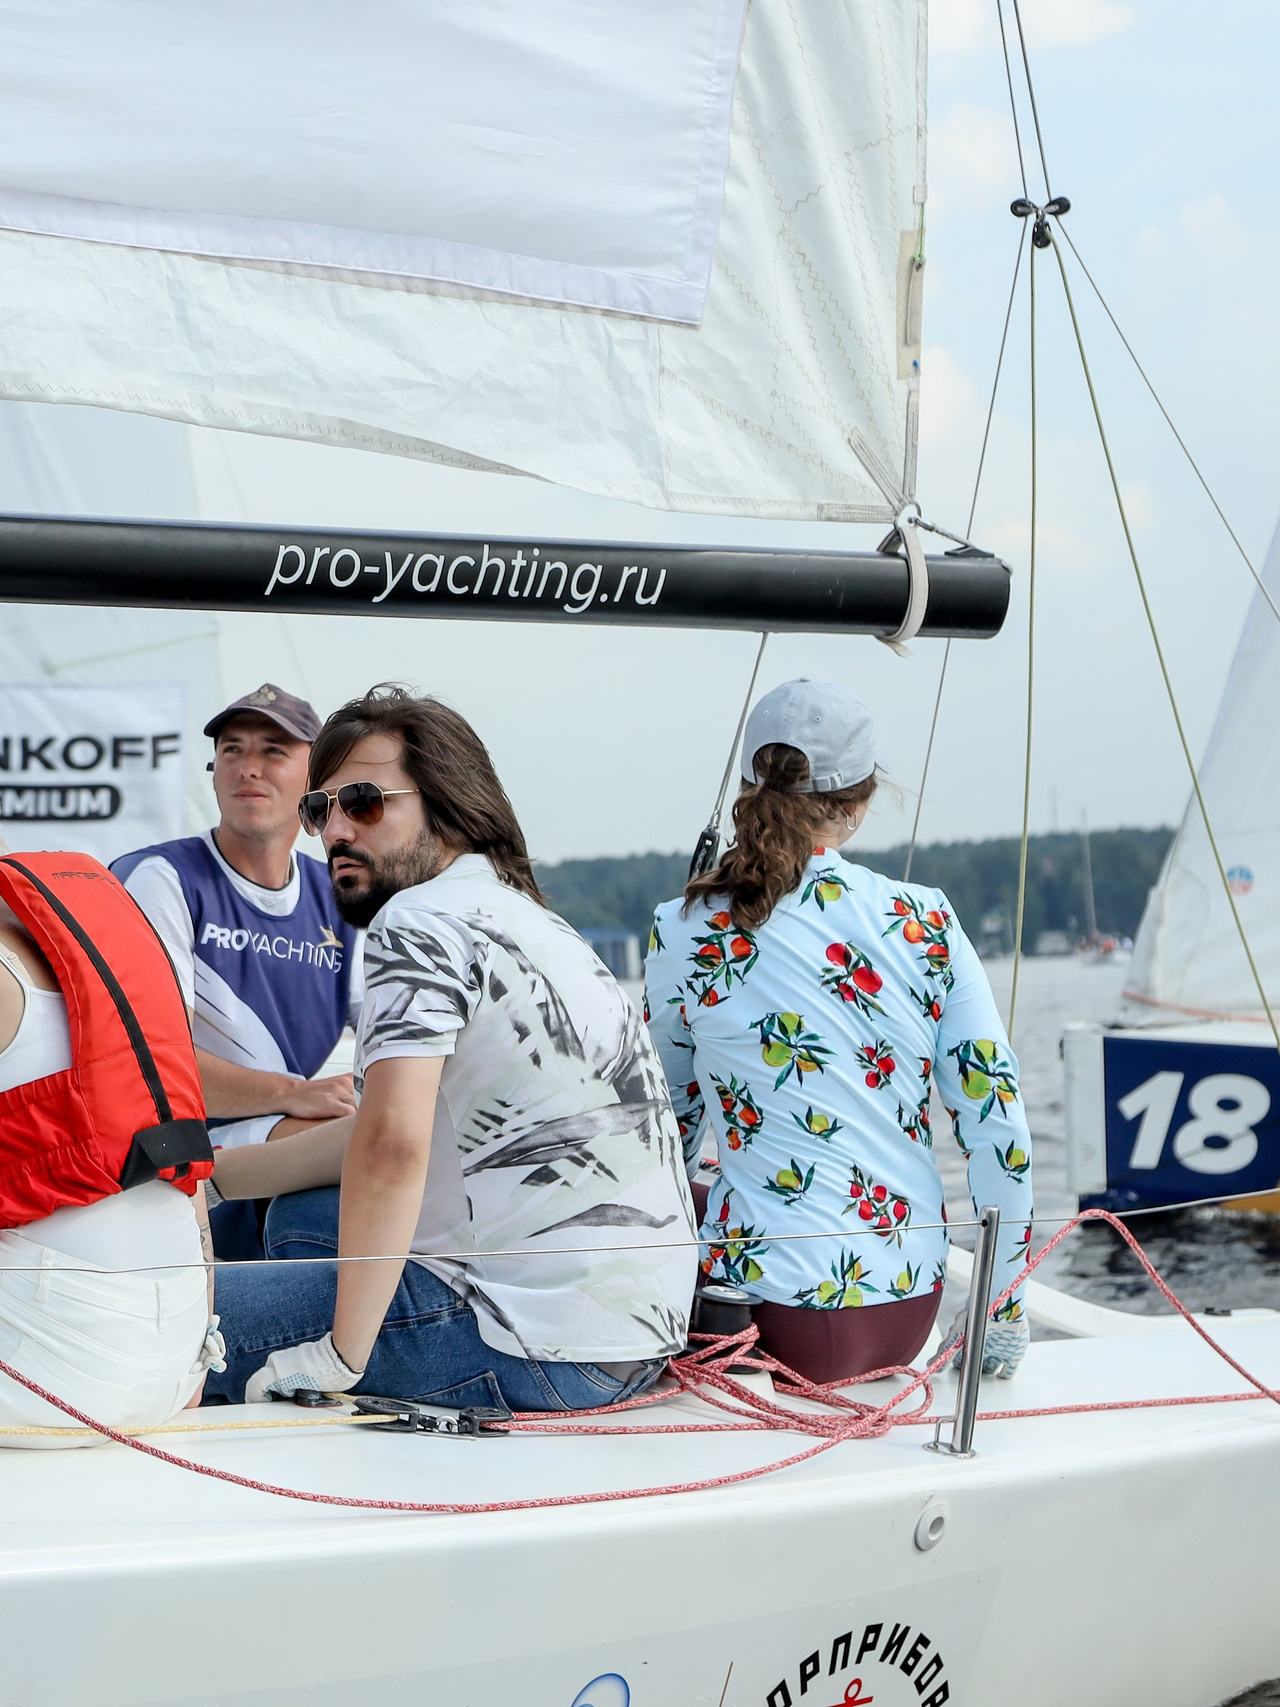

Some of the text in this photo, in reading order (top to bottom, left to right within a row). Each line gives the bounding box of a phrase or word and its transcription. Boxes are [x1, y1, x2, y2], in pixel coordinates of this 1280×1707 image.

[264, 544, 667, 614] pro-yachting.ru
[2, 788, 111, 818] MIUM
[201, 922, 343, 974] PROYACHTING
[1117, 1070, 1271, 1175] 18
